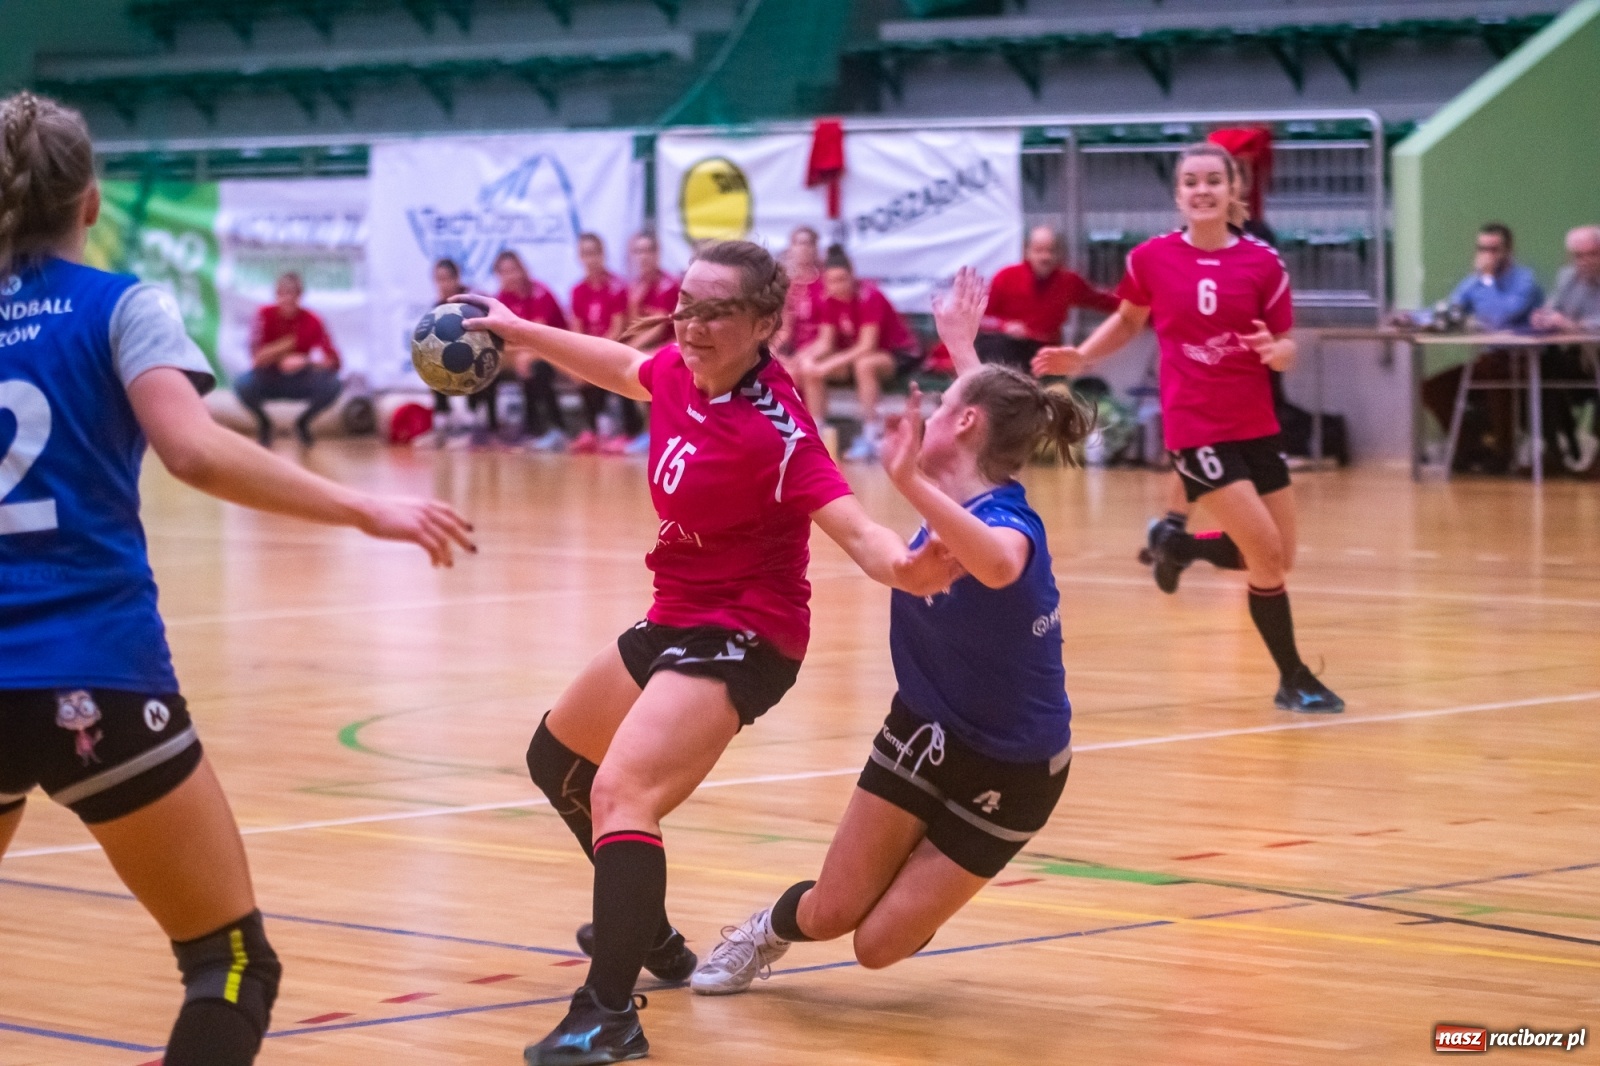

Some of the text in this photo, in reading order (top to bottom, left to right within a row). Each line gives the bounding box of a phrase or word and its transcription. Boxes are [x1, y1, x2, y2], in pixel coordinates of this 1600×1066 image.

[0, 297, 73, 321] NDBALL
[1197, 278, 1218, 315] 6
[0, 379, 59, 535] 2
[653, 435, 697, 494] 15
[1197, 446, 1224, 480] 6
